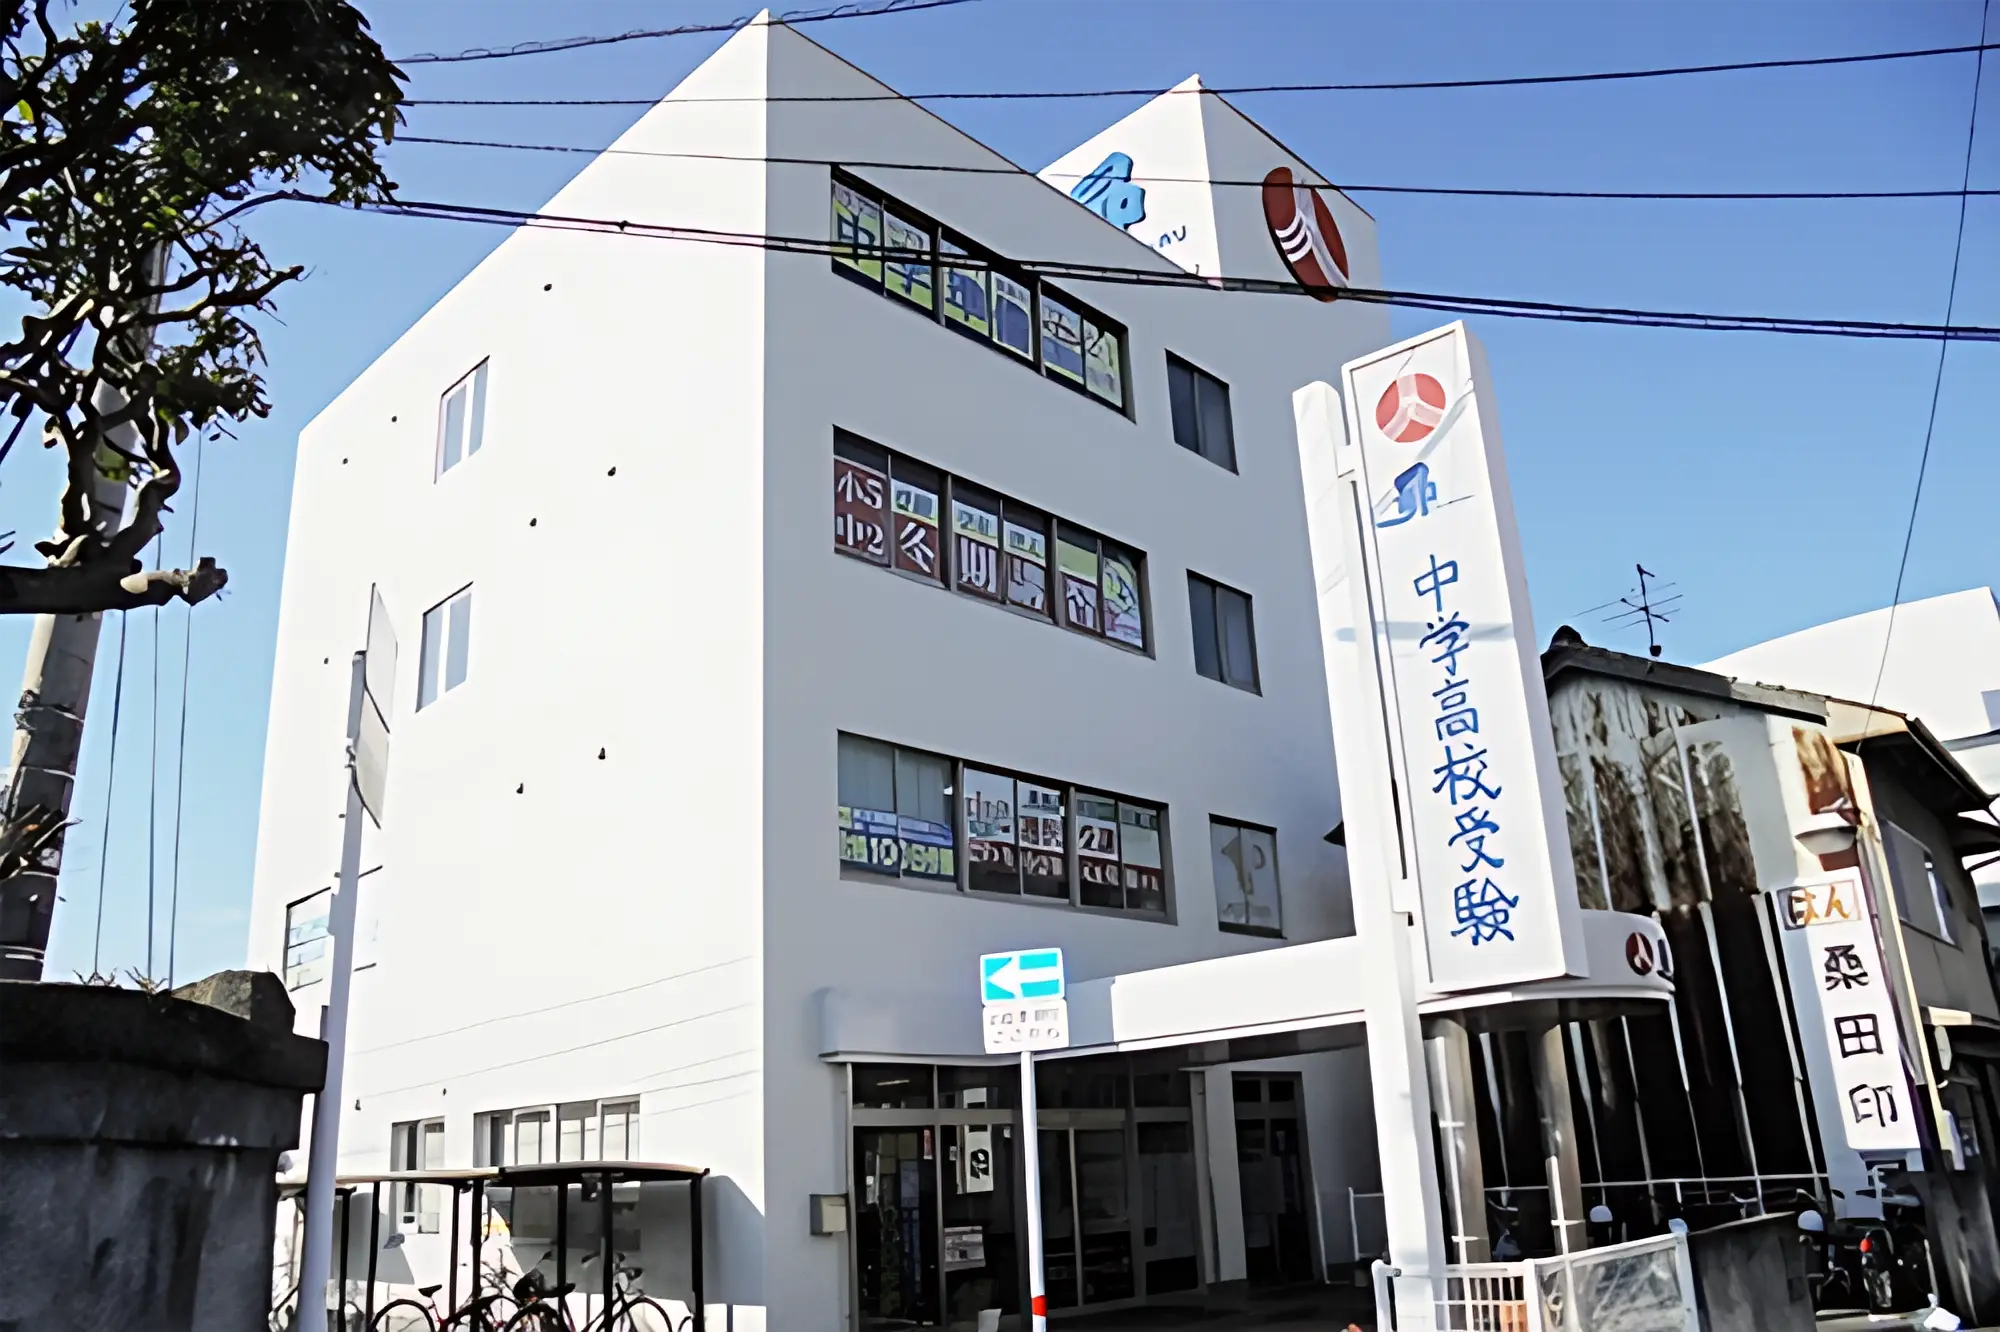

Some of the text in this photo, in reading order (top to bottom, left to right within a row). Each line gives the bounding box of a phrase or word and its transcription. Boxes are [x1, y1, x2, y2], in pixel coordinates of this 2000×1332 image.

[1413, 554, 1519, 946] 中学高校受験
